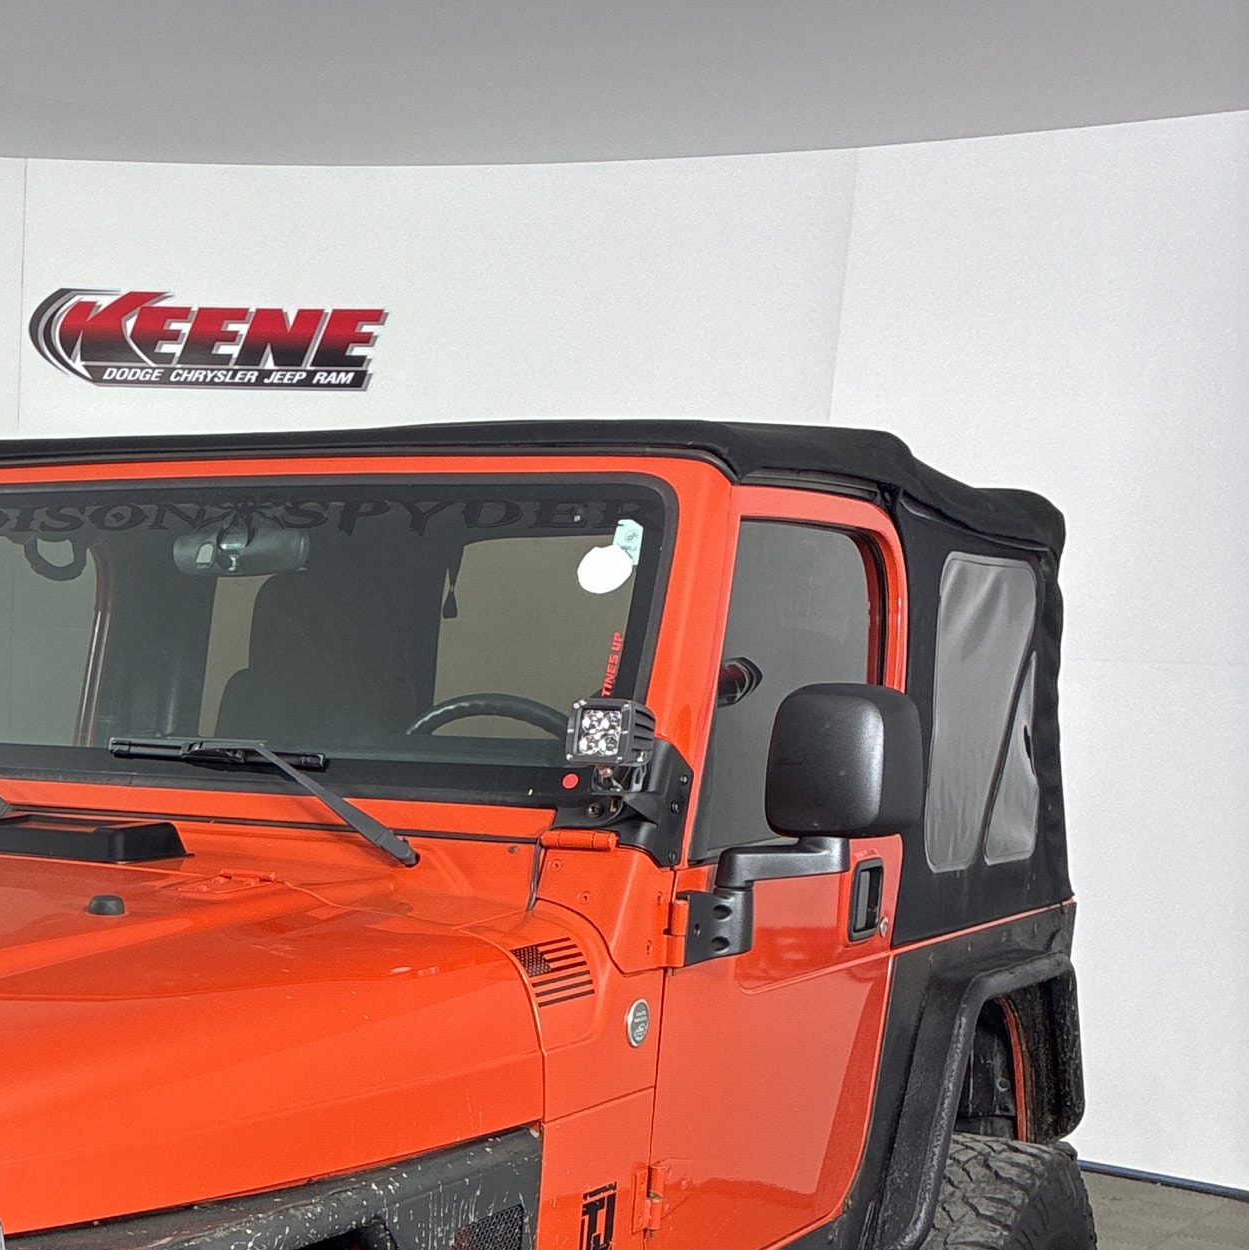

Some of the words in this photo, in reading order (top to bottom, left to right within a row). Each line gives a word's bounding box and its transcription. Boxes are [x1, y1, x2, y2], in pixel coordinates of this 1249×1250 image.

[58, 291, 388, 368] KEENE
[102, 367, 164, 382] DODGE
[169, 368, 258, 384] CHRYSLER
[263, 370, 307, 385] JEEP
[312, 371, 356, 386] RAM
[286, 499, 643, 537] SPYDER
[601, 655, 619, 697] TINES
[611, 631, 623, 650] UP
